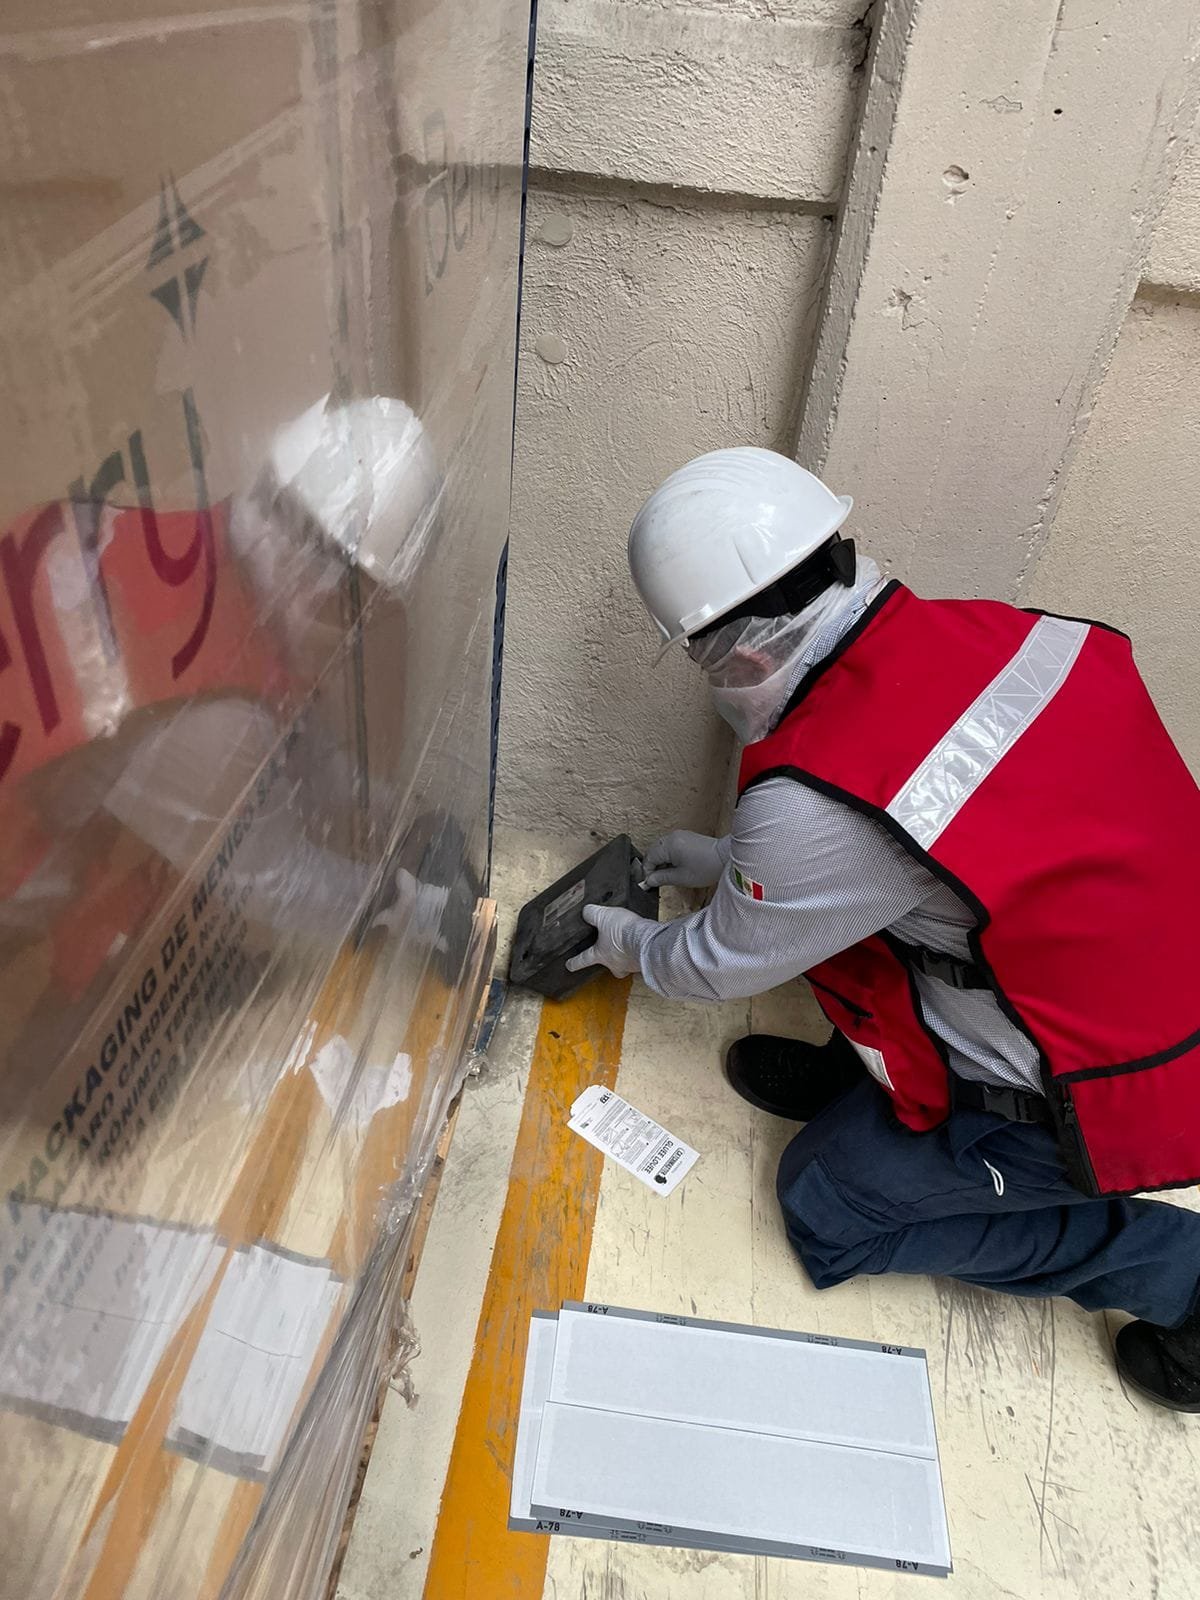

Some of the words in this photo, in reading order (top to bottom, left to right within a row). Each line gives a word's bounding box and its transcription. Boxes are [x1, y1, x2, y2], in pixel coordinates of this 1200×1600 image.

[160, 912, 192, 973] DE
[656, 1139, 674, 1158] GLUEE
[643, 1155, 661, 1174] LOUEE
[587, 1305, 609, 1315] A-78
[881, 1345, 902, 1355] A-78
[559, 1508, 584, 1519] A-78
[536, 1521, 560, 1531] A-78
[895, 1559, 919, 1570] A-78
